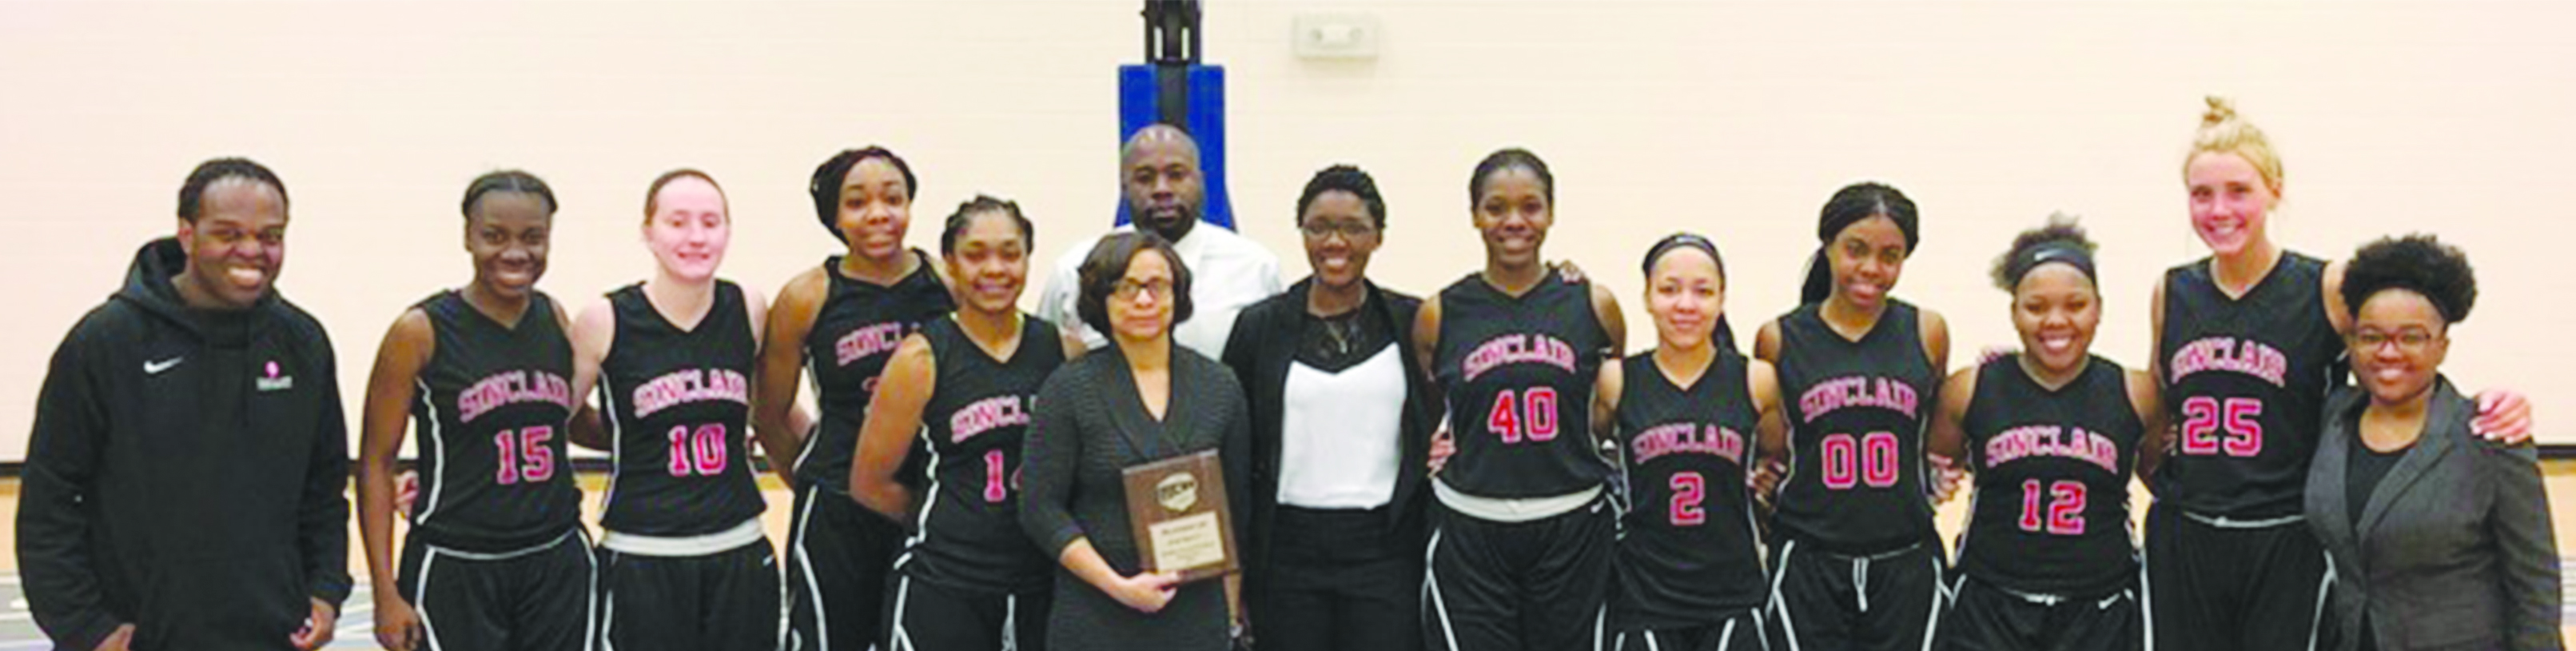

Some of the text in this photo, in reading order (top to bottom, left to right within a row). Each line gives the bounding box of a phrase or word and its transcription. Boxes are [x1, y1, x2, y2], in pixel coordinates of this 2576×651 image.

[836, 322, 919, 366] SINCL
[1463, 333, 1576, 382] SINCLAIR
[2171, 337, 2287, 388] SINCLAIR
[633, 369, 747, 418] SINCLAIR
[950, 394, 1037, 444] SINCL
[1487, 386, 1558, 443] 40
[1799, 376, 1917, 422] SINCLAIR
[668, 424, 726, 477] 10
[1631, 421, 1743, 465] SINCLAIR
[1985, 425, 2118, 475] SINCLAIR
[2182, 396, 2263, 457] 25
[494, 425, 554, 484] 15
[984, 449, 1024, 502] 1
[1821, 431, 1898, 489] 00
[1669, 472, 1705, 525] 2
[2019, 479, 2087, 534] 12
